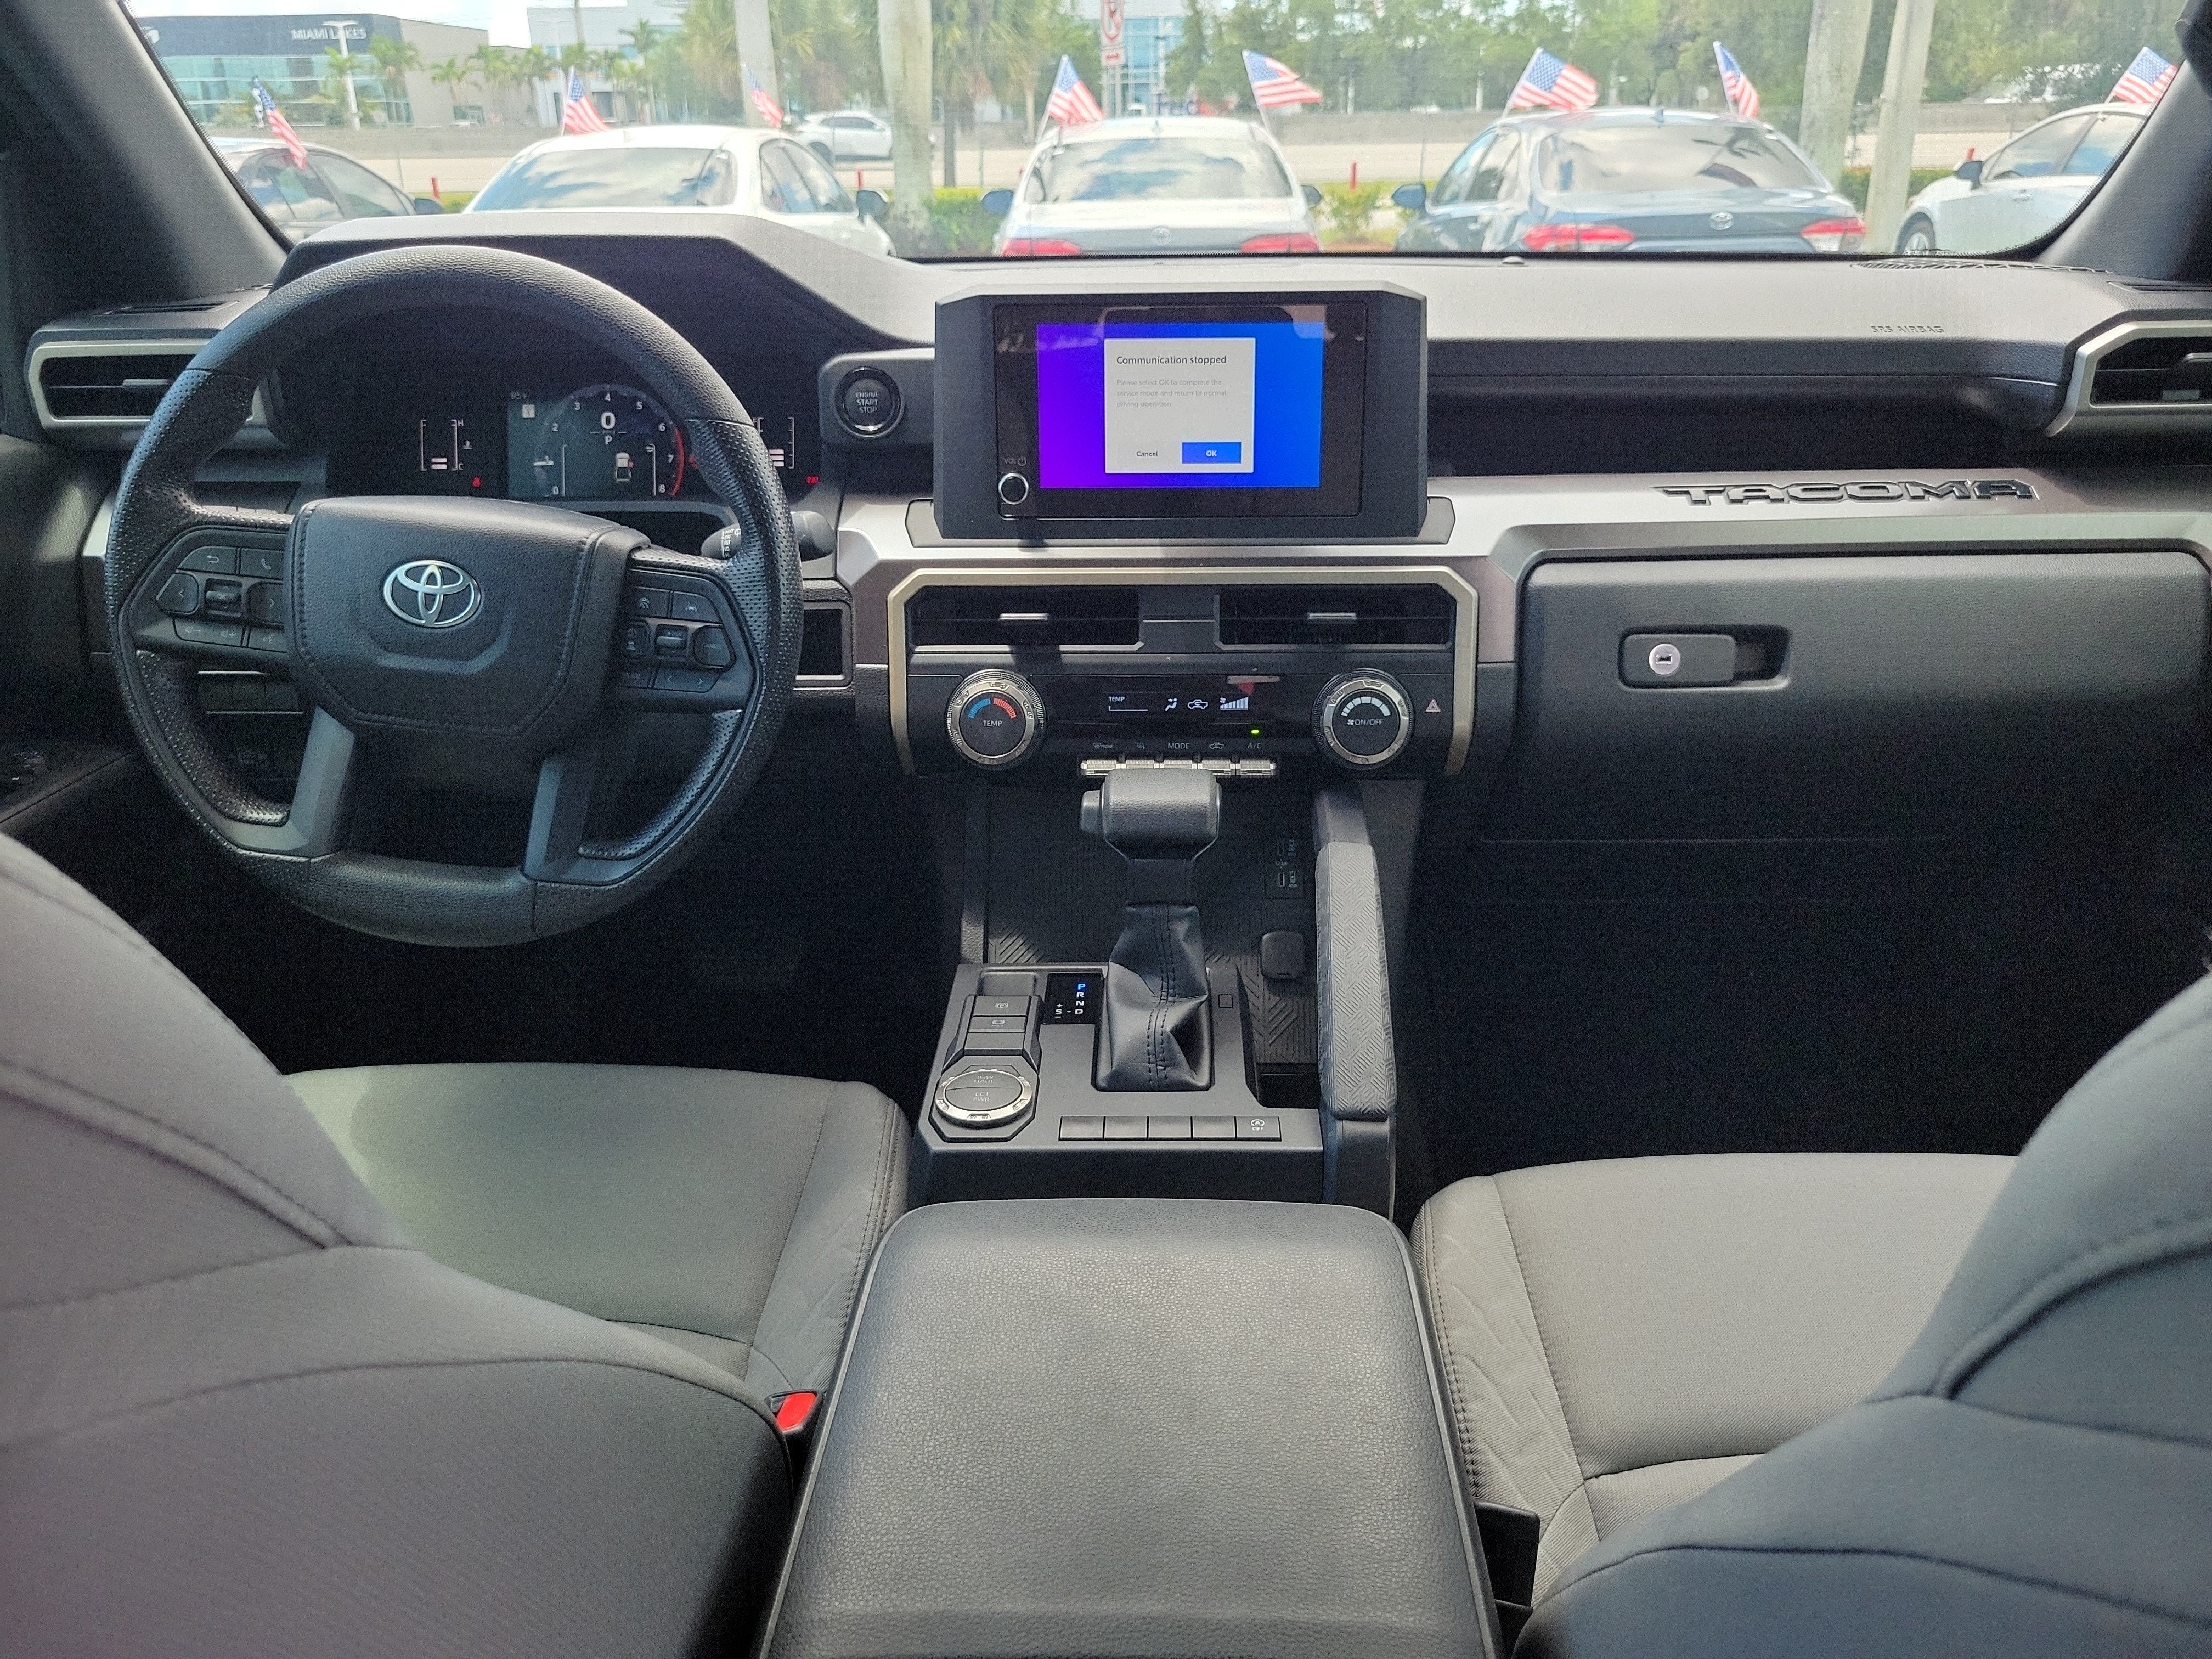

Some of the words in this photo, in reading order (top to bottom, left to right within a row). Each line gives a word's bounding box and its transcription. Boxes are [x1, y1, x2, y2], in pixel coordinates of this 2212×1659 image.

[291, 28, 329, 40] MIAMI
[331, 27, 367, 40] LKES
[1116, 356, 1187, 364] Communication
[1189, 356, 1227, 365] stopped
[605, 392, 612, 402] 4
[574, 402, 581, 410] 3
[636, 401, 644, 410] 5
[600, 411, 616, 430] 0
[552, 422, 559, 432] 2
[659, 422, 666, 432] 6
[605, 435, 613, 445] P
[667, 454, 674, 464] 7
[552, 486, 560, 494] 0
[659, 483, 666, 493] 8
[1654, 479, 2038, 506] TACOMA
